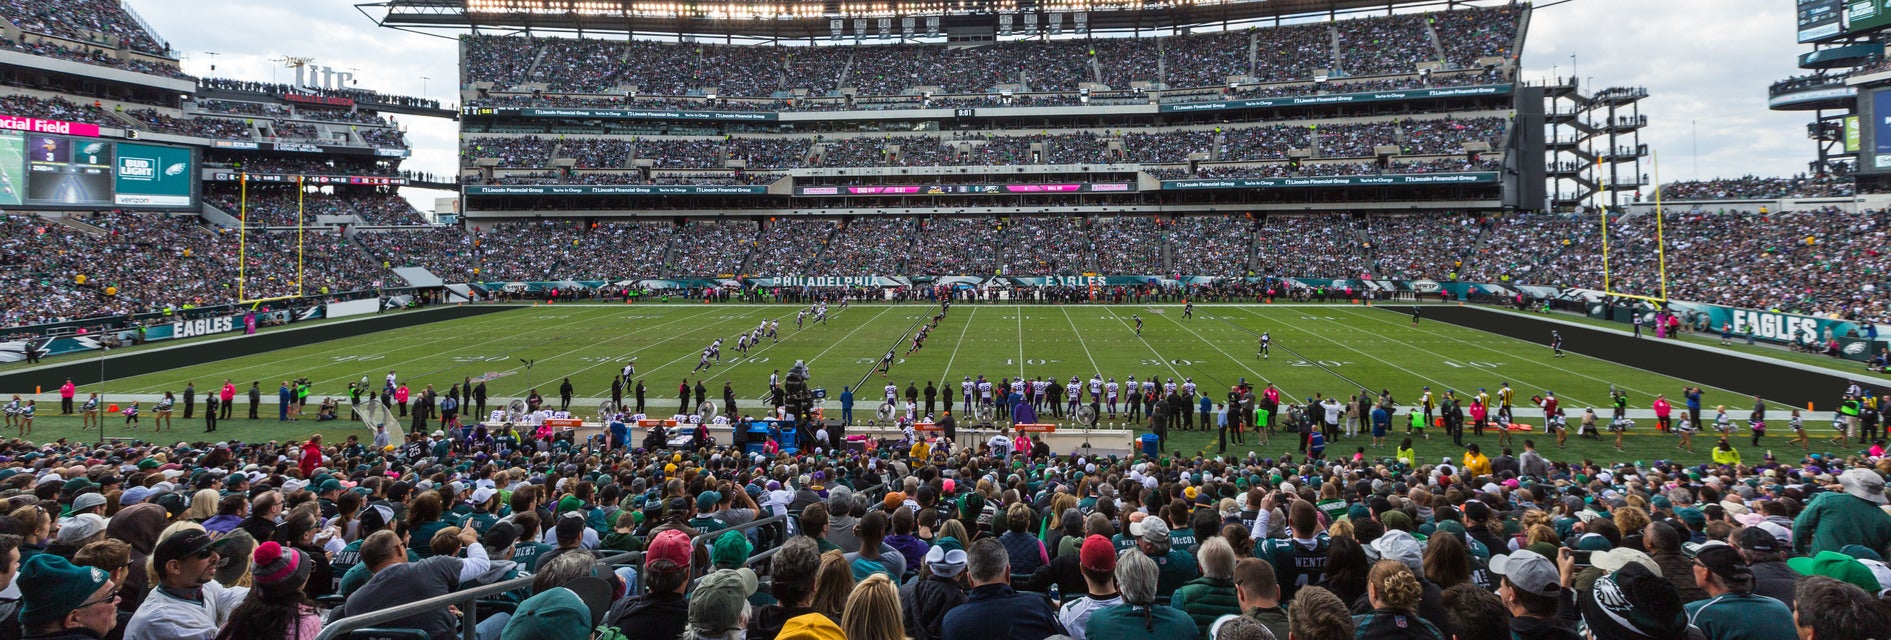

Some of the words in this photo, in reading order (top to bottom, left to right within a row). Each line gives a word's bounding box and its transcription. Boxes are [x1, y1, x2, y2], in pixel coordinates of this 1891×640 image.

[283, 55, 315, 68] Miller
[327, 97, 354, 106] DECK
[35, 120, 70, 134] Field
[125, 159, 149, 168] BUD
[121, 166, 153, 176] LIGHT
[773, 276, 880, 286] PHILADELPHIA
[1045, 276, 1106, 286] EAGLES
[173, 316, 233, 338] EAGLES
[1733, 310, 1818, 344] EAGLES
[409, 445, 421, 457] 25
[995, 444, 1007, 455] 20
[1171, 536, 1197, 545] McCOY
[514, 545, 537, 557] HEWS
[1295, 556, 1328, 568] WENTZ
